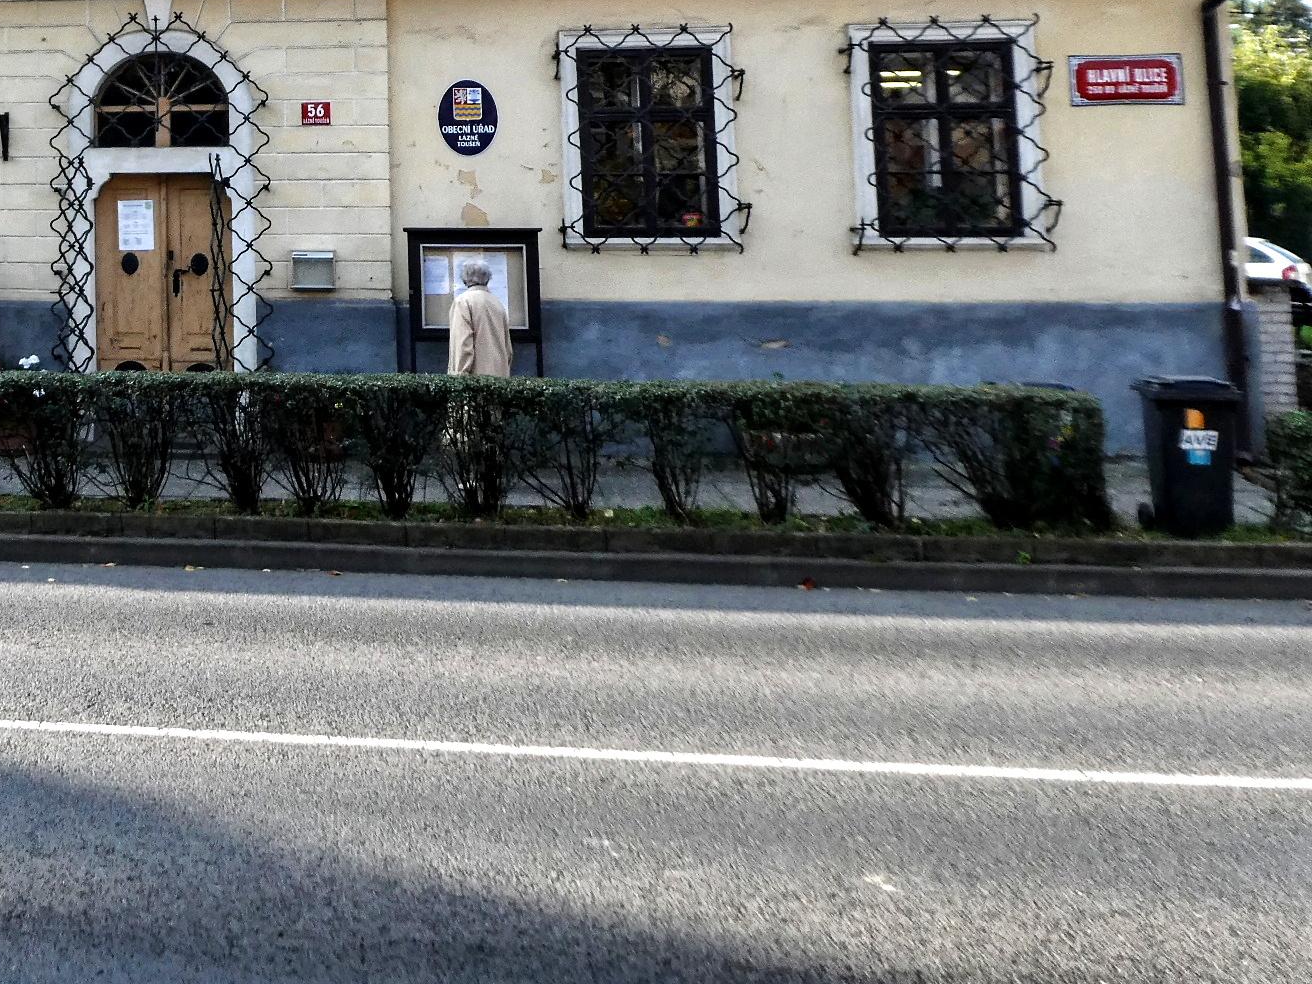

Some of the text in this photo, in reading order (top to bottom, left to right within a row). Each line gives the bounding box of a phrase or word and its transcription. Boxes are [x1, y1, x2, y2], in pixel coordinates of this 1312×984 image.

[1087, 66, 1168, 82] HLAVNÍ ULICE
[308, 104, 325, 117] 56
[442, 123, 495, 133] OBECNÍ ÚŘAD
